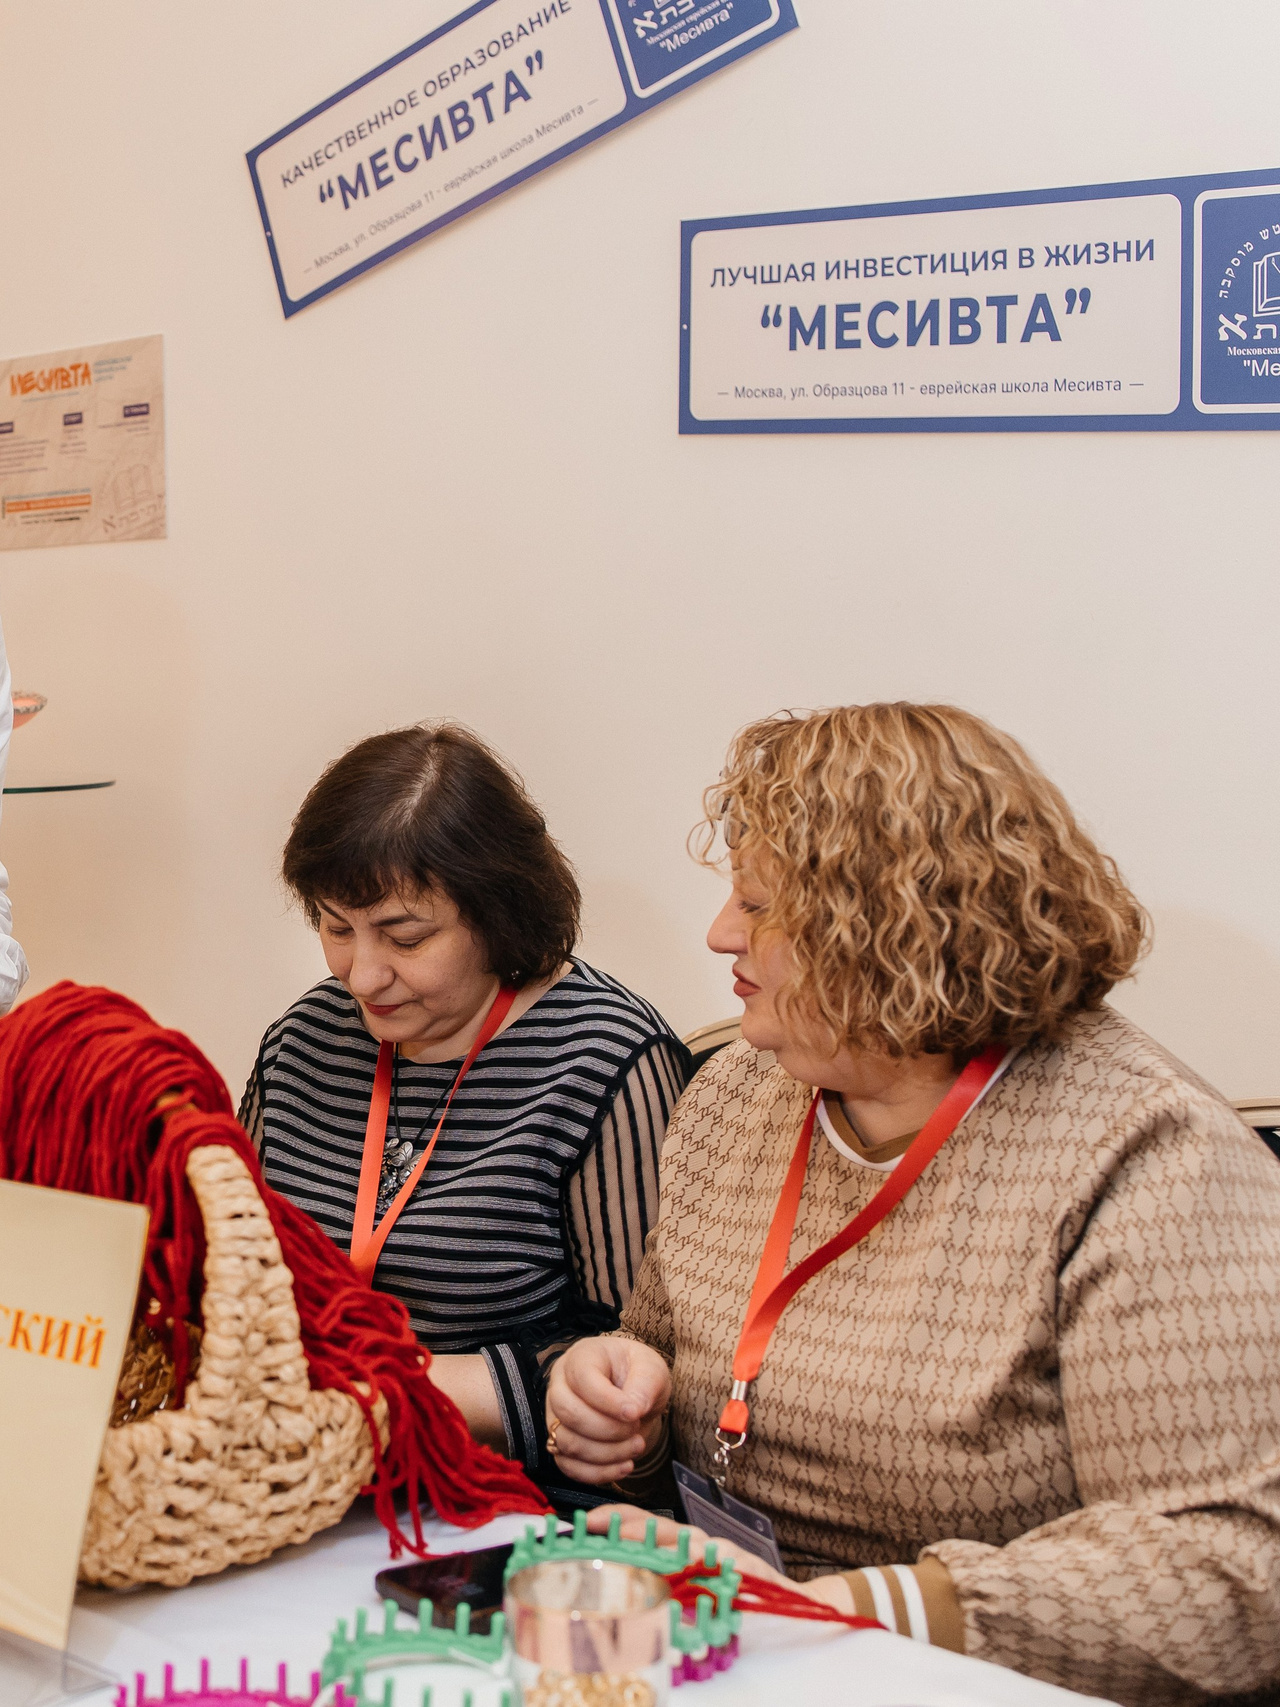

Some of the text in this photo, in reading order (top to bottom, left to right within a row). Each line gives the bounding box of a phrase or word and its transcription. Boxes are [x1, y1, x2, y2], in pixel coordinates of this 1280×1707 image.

[281, 0, 572, 188] КАЧЕСТВЕННОЕ ОБРАЗОВАНИЕ
[369, 198, 424, 237] Образцова
[424, 190, 435, 203] 11
[443, 156, 498, 193] еврейская
[500, 134, 534, 160] школа
[535, 105, 585, 140] Месивта
[710, 239, 1155, 288] ЛУЧШАЯ ИНВЕСТИЦИЯ В ЖИЗНИ
[734, 384, 786, 400] Москва,
[790, 387, 808, 401] ул.
[812, 383, 887, 399] Образцова
[893, 382, 904, 395] 11
[920, 379, 997, 397] еврейская
[1001, 379, 1048, 393] школа
[1054, 378, 1121, 391] Месивта
